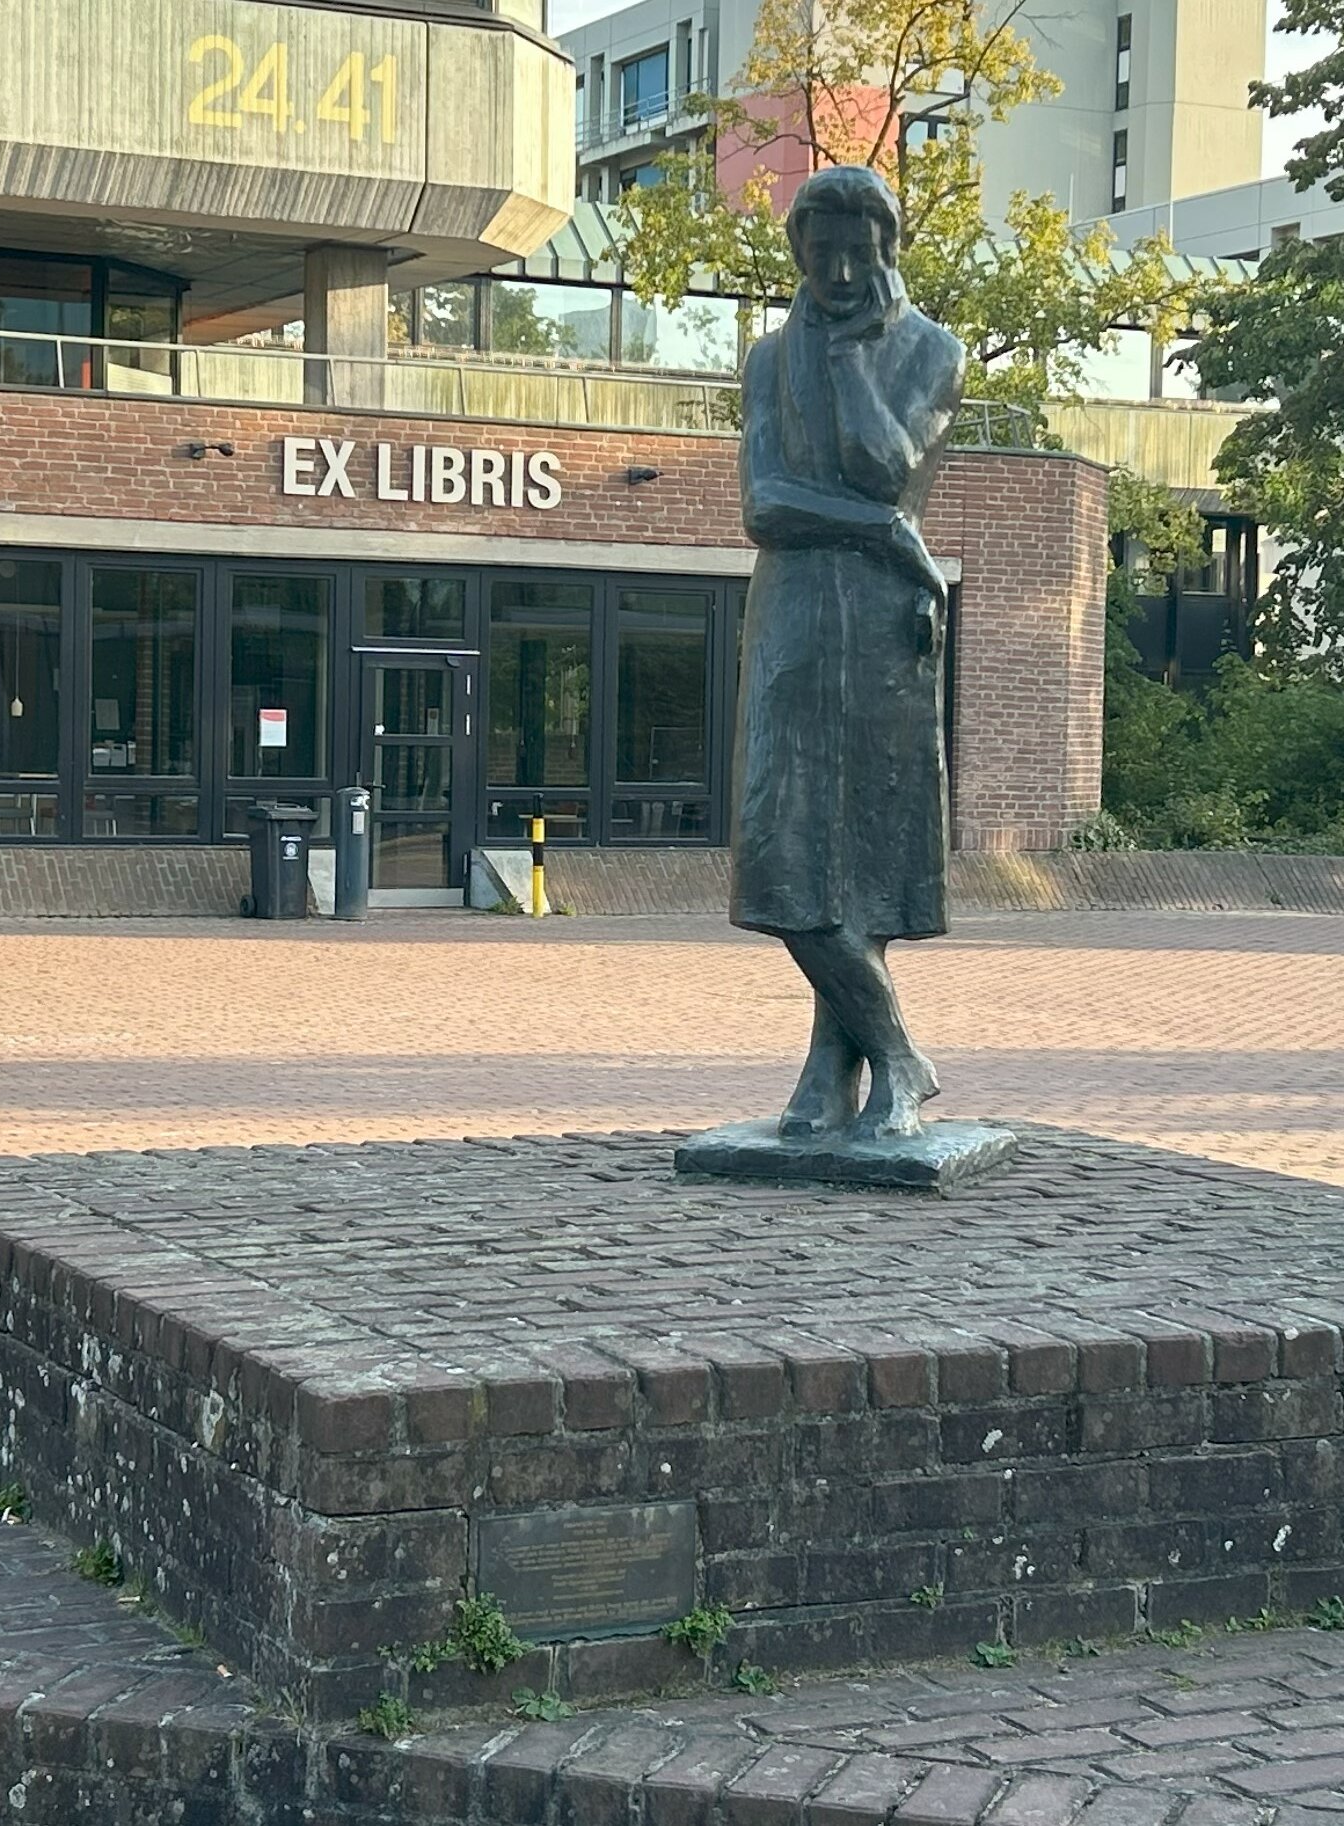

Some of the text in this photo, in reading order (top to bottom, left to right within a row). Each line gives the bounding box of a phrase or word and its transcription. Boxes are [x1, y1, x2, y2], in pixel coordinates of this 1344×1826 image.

[188, 34, 397, 144] 24.41
[283, 437, 562, 509] EX LIBRIS
